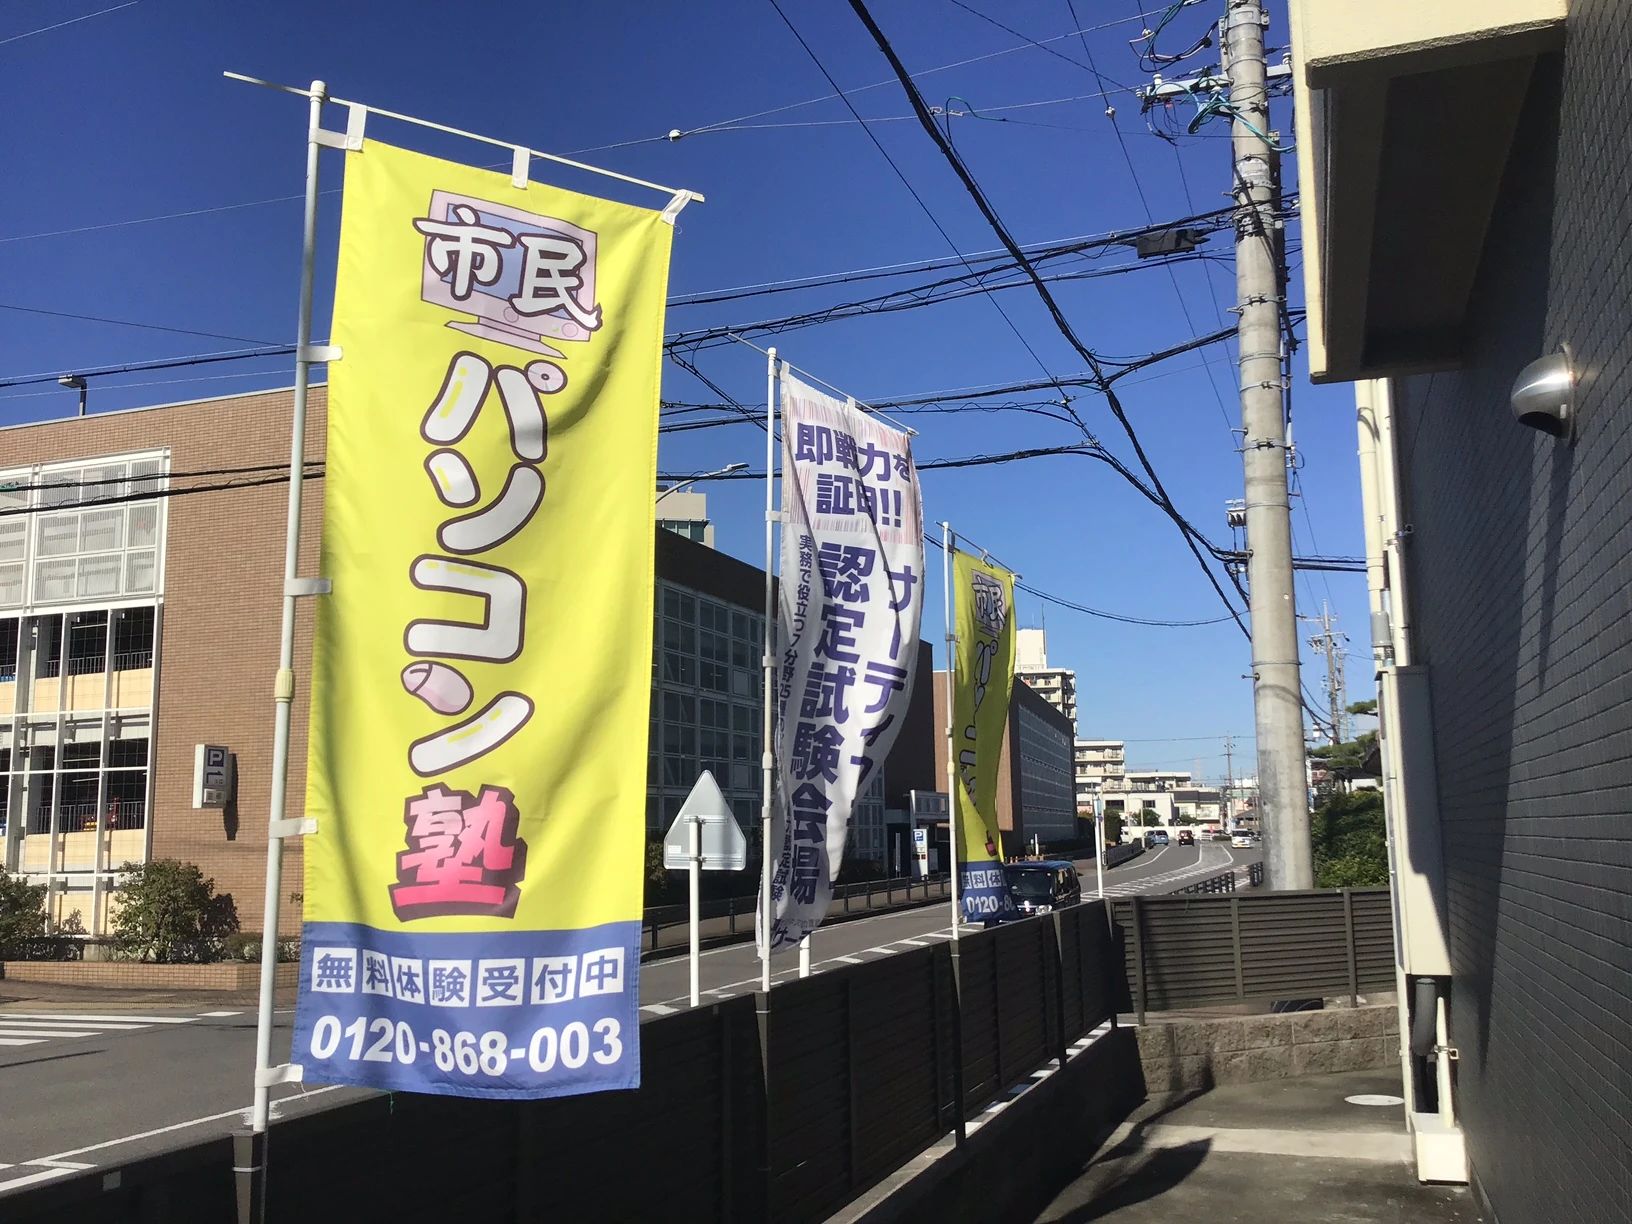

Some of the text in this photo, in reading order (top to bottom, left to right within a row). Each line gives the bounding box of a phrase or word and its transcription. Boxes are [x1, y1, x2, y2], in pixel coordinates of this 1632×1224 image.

[413, 204, 603, 332] 市民
[795, 422, 912, 483] 即戦力を
[209, 750, 223, 765] P
[313, 951, 622, 1006] 無料体験受付中
[309, 1015, 624, 1077] 0120-868-003
